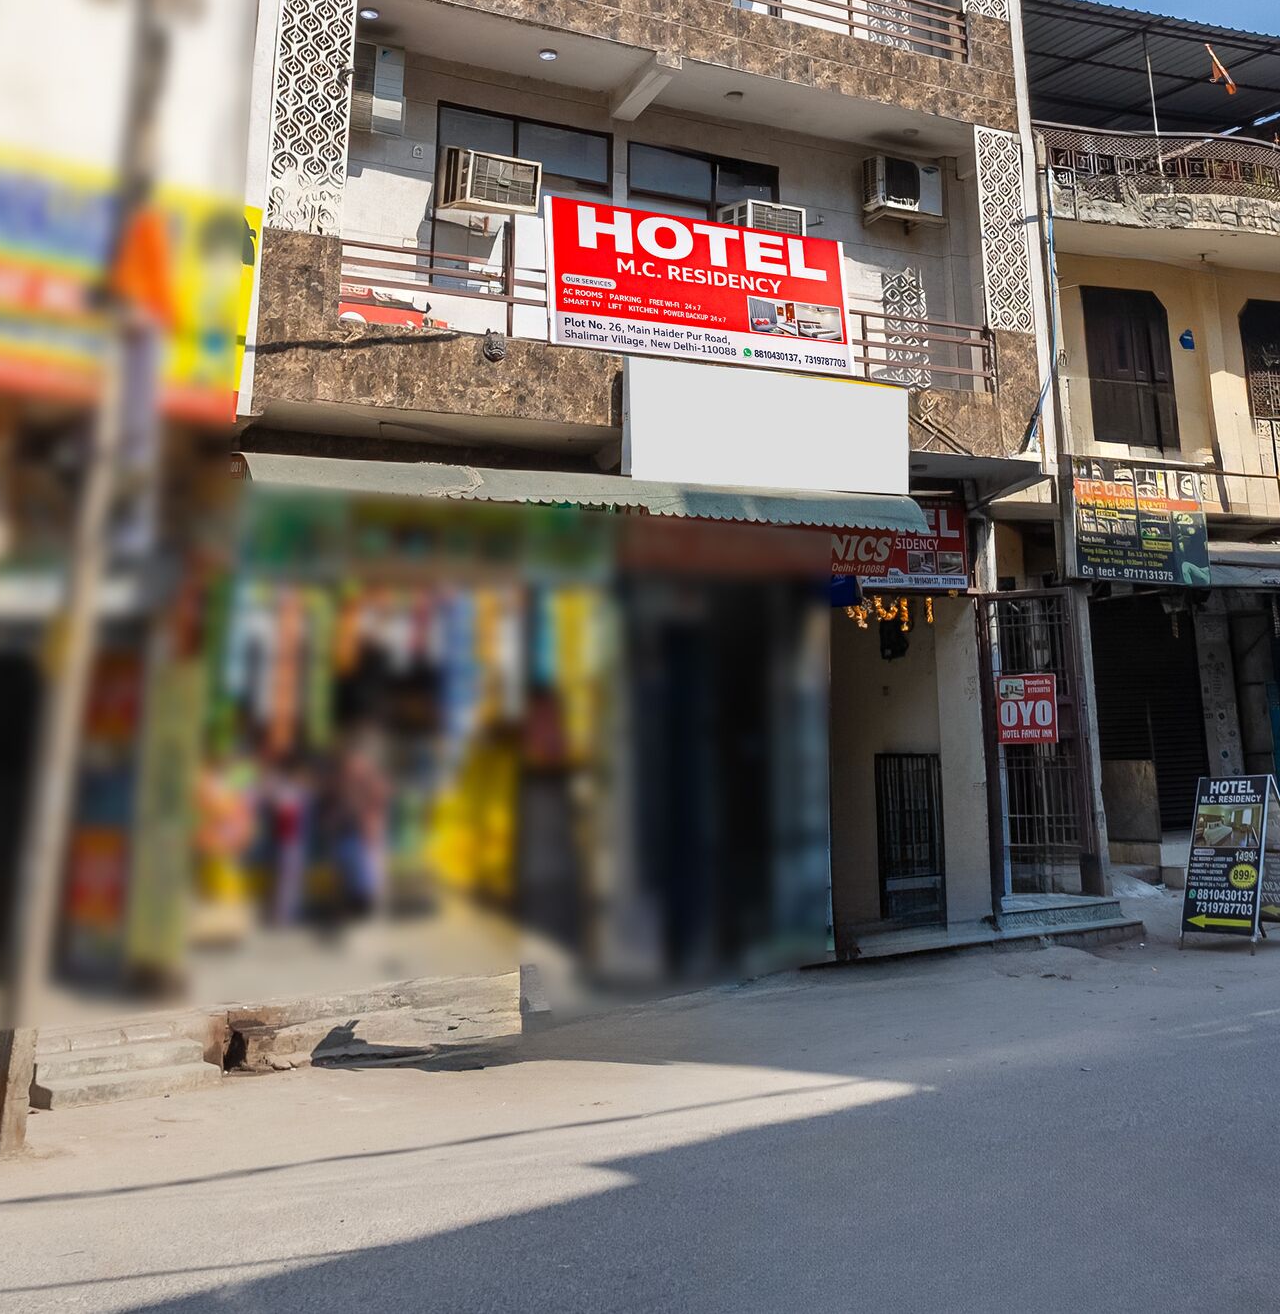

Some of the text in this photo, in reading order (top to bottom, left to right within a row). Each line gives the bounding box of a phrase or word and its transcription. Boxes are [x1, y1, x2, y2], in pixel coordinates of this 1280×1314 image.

[577, 205, 827, 281] HOTEL
[581, 277, 612, 287] SERVICES
[617, 258, 781, 294] M.C. RESIDENCY
[575, 289, 603, 298] ROOMS
[609, 294, 642, 304] PARKING
[563, 298, 589, 306] SMART
[628, 306, 658, 314] KITCHEN
[664, 310, 685, 318] POWER
[686, 312, 708, 320] BACKUP
[564, 317, 731, 346] Plot No. 26, Main Haider Pur Road,
[565, 329, 847, 368] Shalimar Village, New Delhi-110088 8810430137, 7319787703
[831, 562, 885, 574] Delhi-110088
[1001, 700, 1053, 727] OYO
[1002, 730, 1020, 739] HOTEL
[1021, 729, 1041, 739] FAMILY
[1210, 781, 1254, 795] HOTEL
[1201, 794, 1261, 804] M.C. RESIDENCY
[1233, 870, 1255, 880] 899/-
[1197, 888, 1254, 902] 8810430137
[1195, 901, 1253, 916] 7319787703
